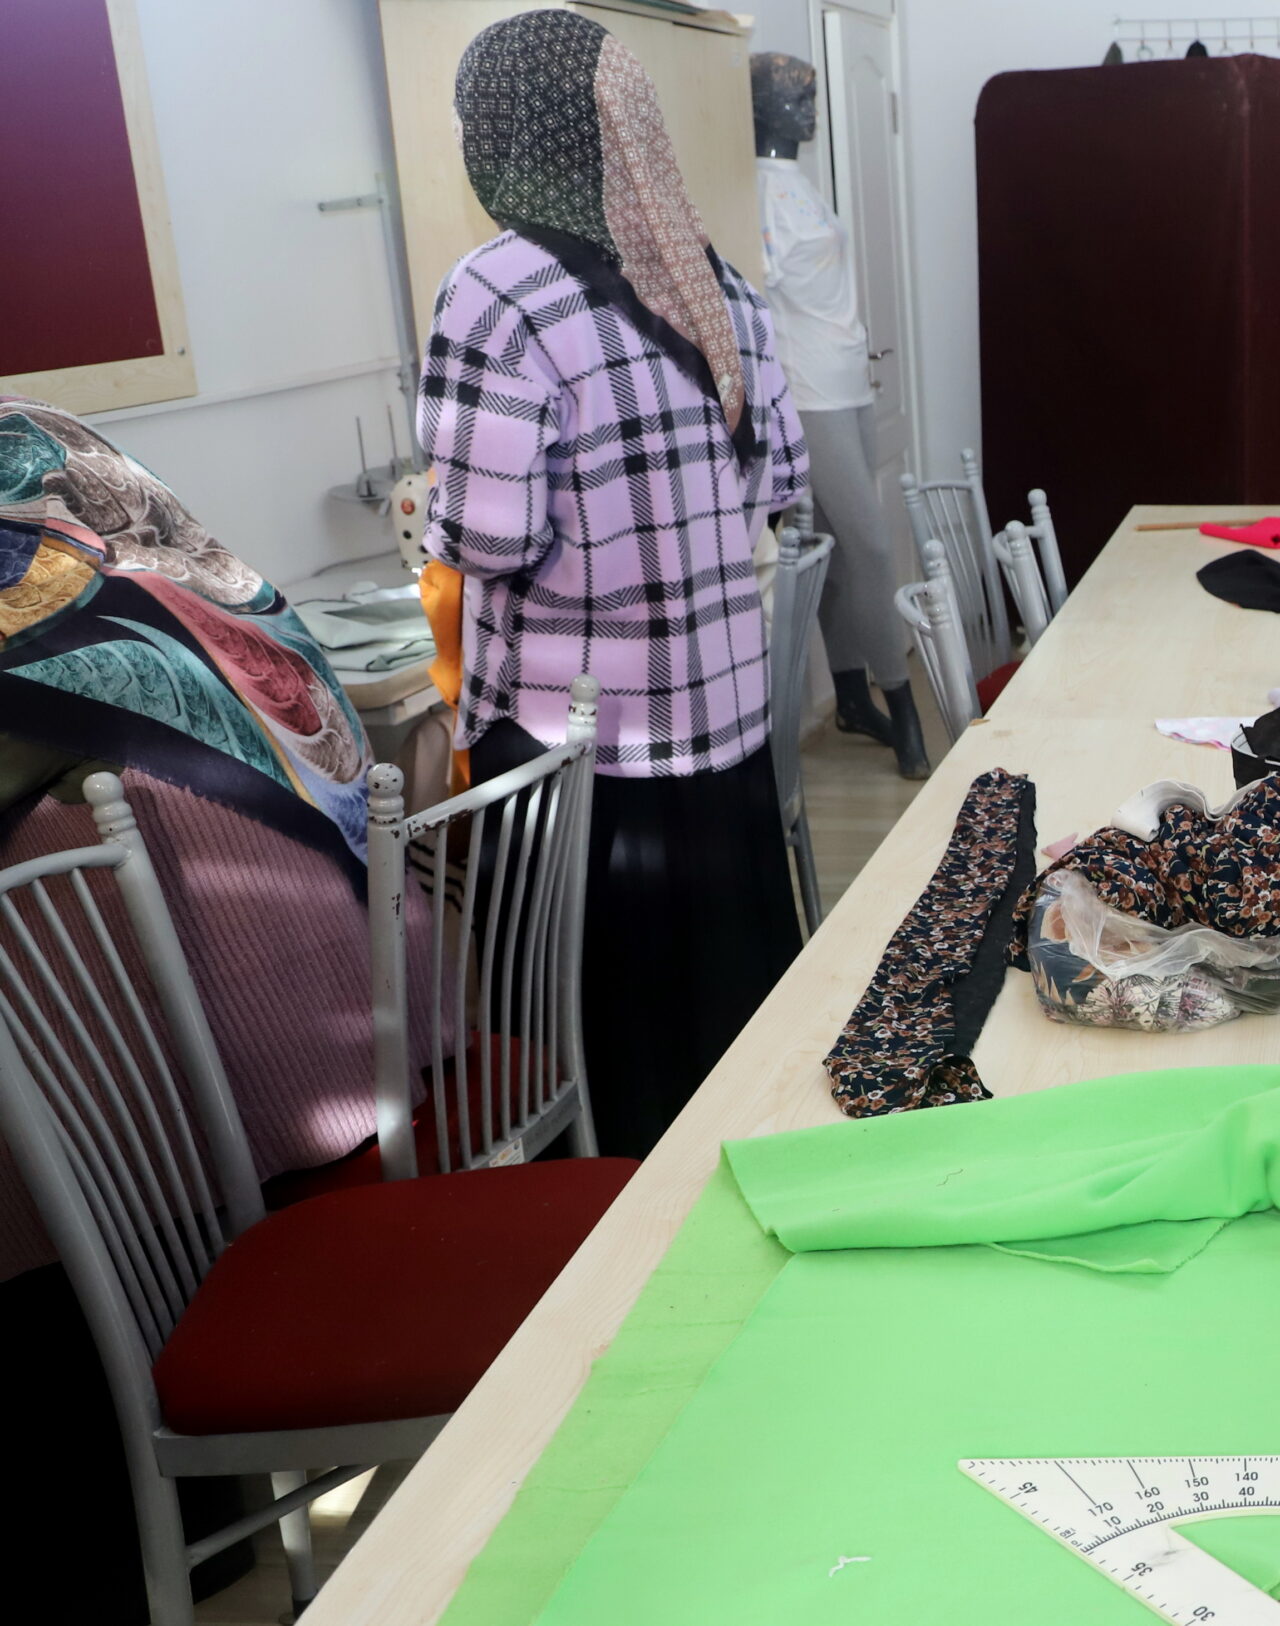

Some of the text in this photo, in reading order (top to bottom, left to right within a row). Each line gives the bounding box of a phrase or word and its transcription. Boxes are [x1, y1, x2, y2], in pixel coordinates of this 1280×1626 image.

[1185, 1476, 1209, 1488] 150
[1235, 1472, 1258, 1482] 140
[1018, 1482, 1039, 1494] 45
[1135, 1486, 1160, 1501] 160
[1238, 1486, 1255, 1496] 40
[1193, 1491, 1209, 1502] 30
[1087, 1501, 1114, 1517] 170
[1146, 1501, 1165, 1513] 20
[1103, 1515, 1122, 1528] 10
[1131, 1562, 1153, 1577] 35
[1192, 1605, 1216, 1622] 30
